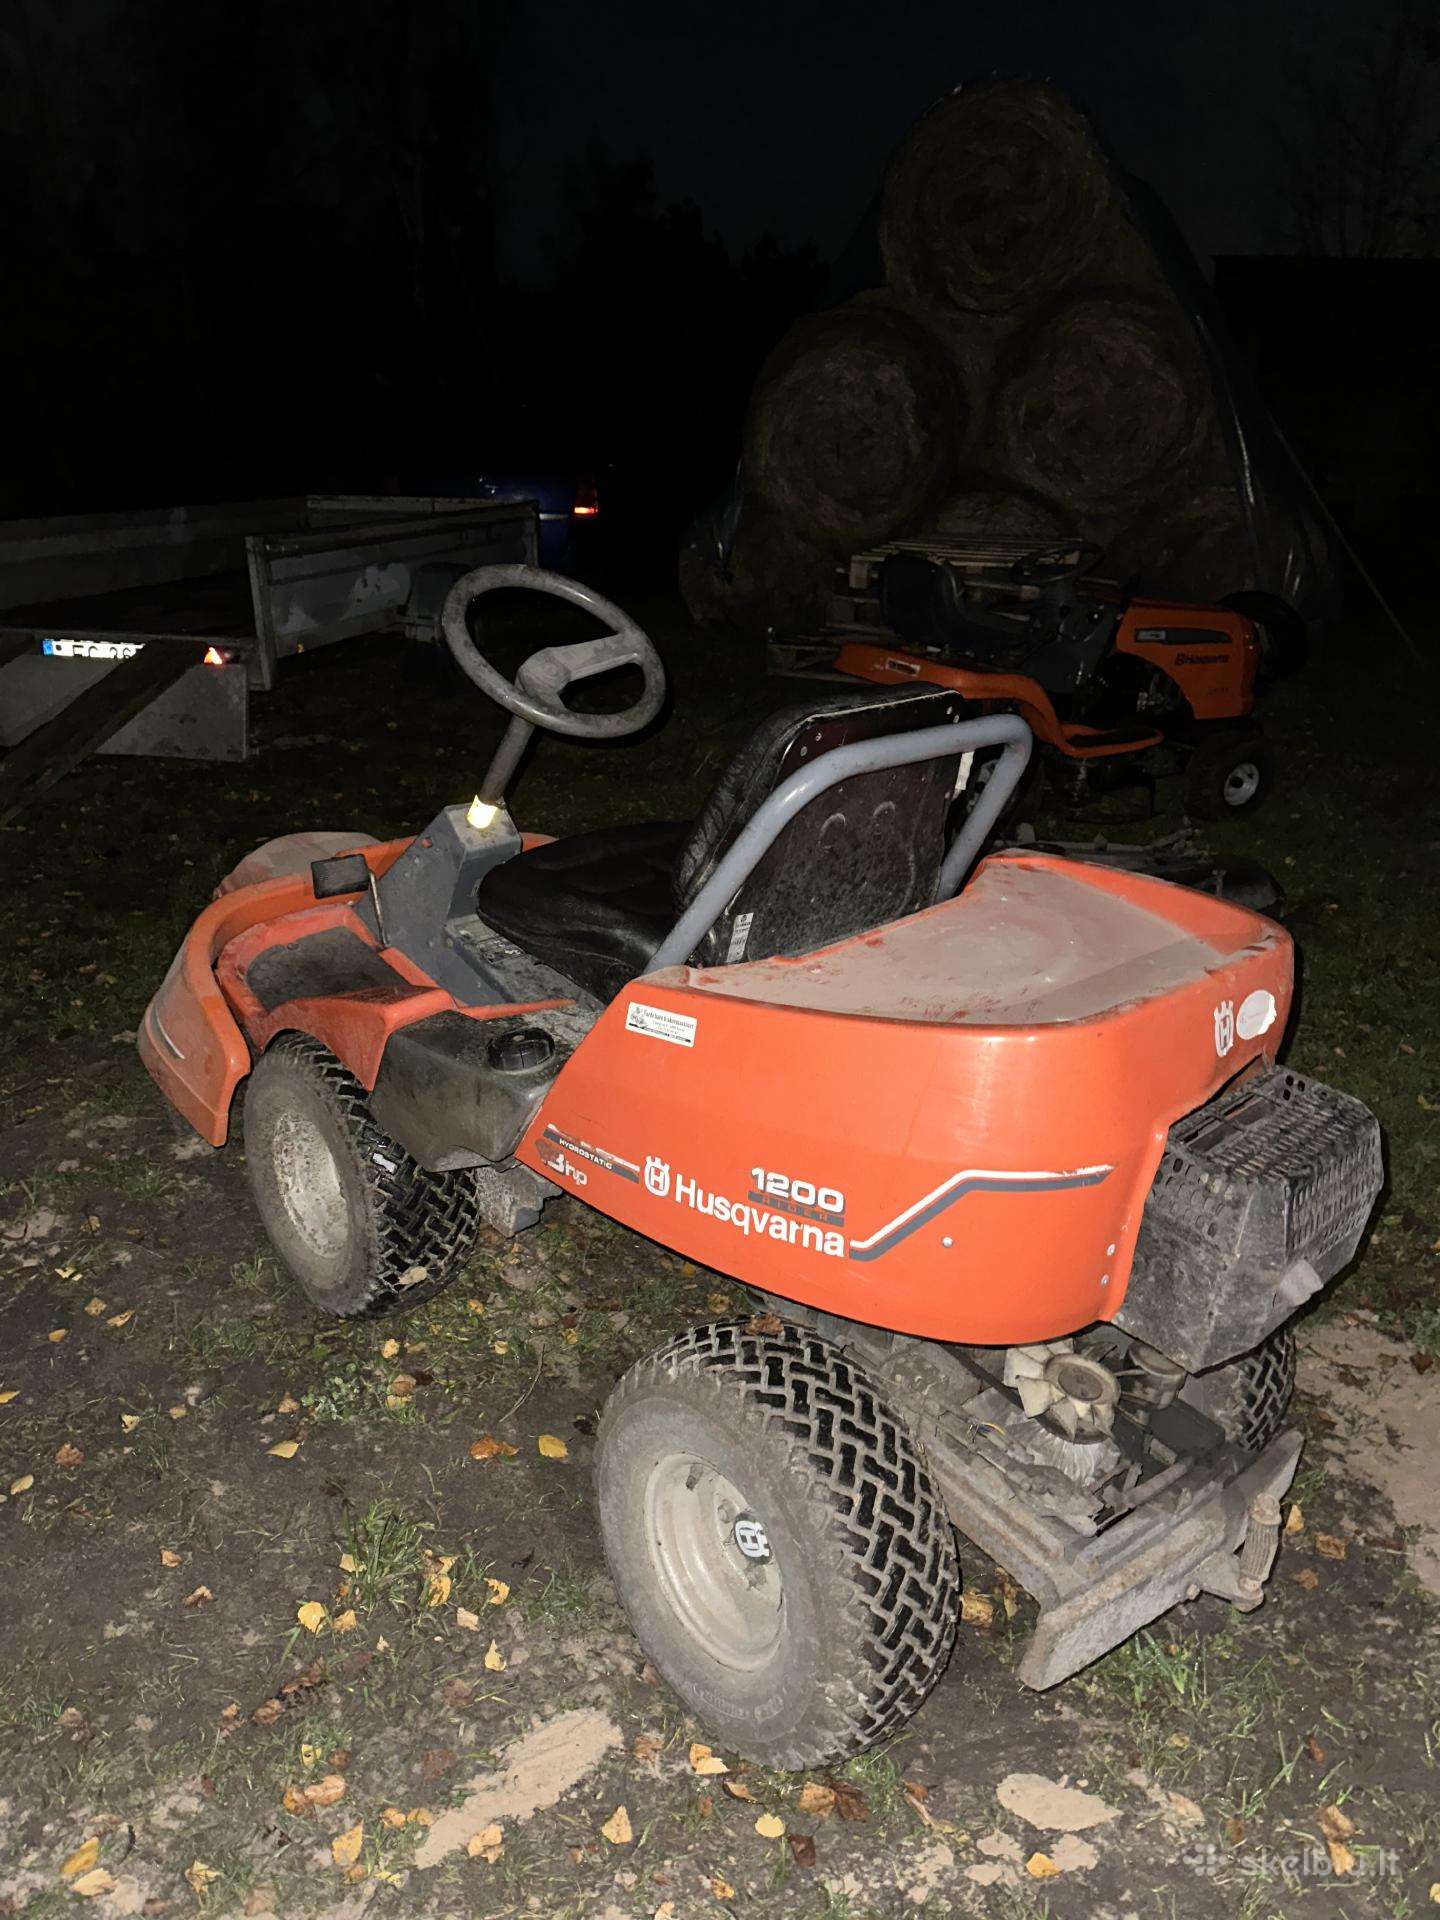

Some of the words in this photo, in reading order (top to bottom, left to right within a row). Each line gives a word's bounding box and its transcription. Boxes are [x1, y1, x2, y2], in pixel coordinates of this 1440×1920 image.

[559, 1138, 612, 1170] HYDROSTATIC
[750, 1167, 845, 1213] 1200
[674, 1173, 846, 1258] Husqvarna
